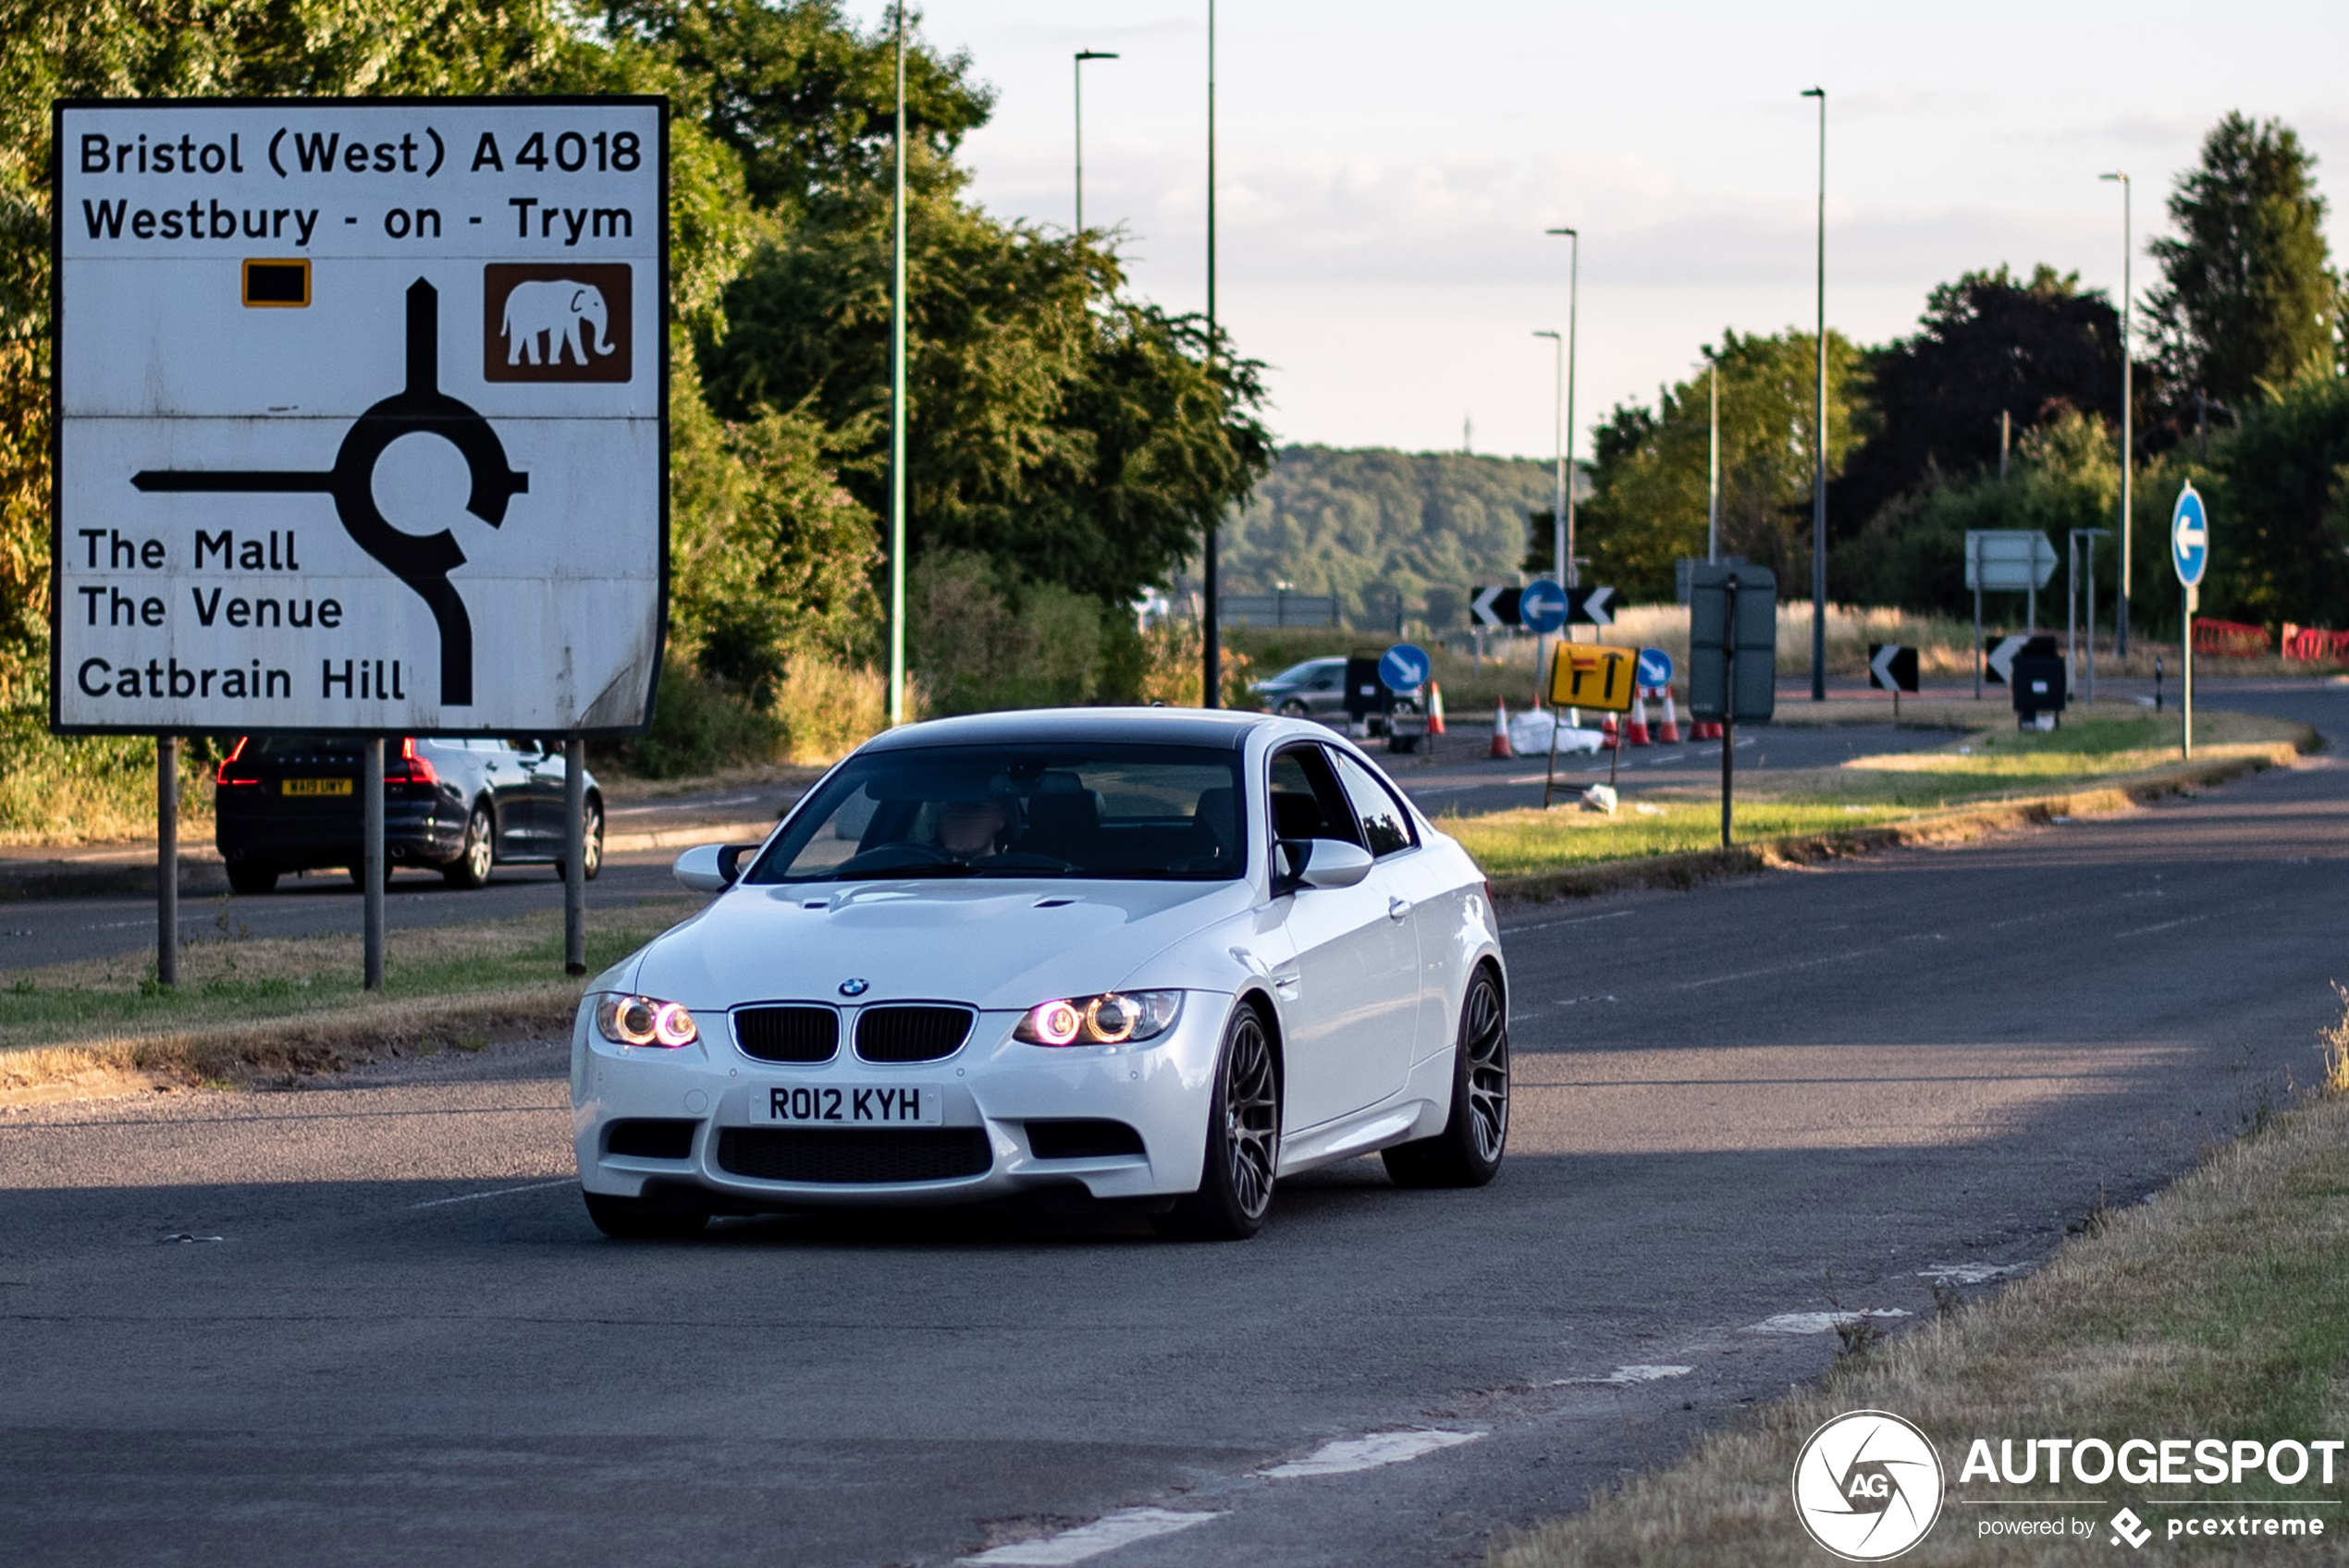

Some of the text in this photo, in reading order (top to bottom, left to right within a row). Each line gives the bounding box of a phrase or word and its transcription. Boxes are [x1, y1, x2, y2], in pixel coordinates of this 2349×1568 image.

[80, 132, 244, 175] Bristol
[267, 126, 446, 179] (West)
[81, 198, 320, 247] Westbury
[384, 208, 442, 239] on
[508, 197, 633, 247] Trym
[78, 528, 300, 571] The Mall
[78, 585, 343, 629] The Venue
[77, 656, 406, 701] Catbrain Hill
[769, 1087, 920, 1121] RO12 KYH
